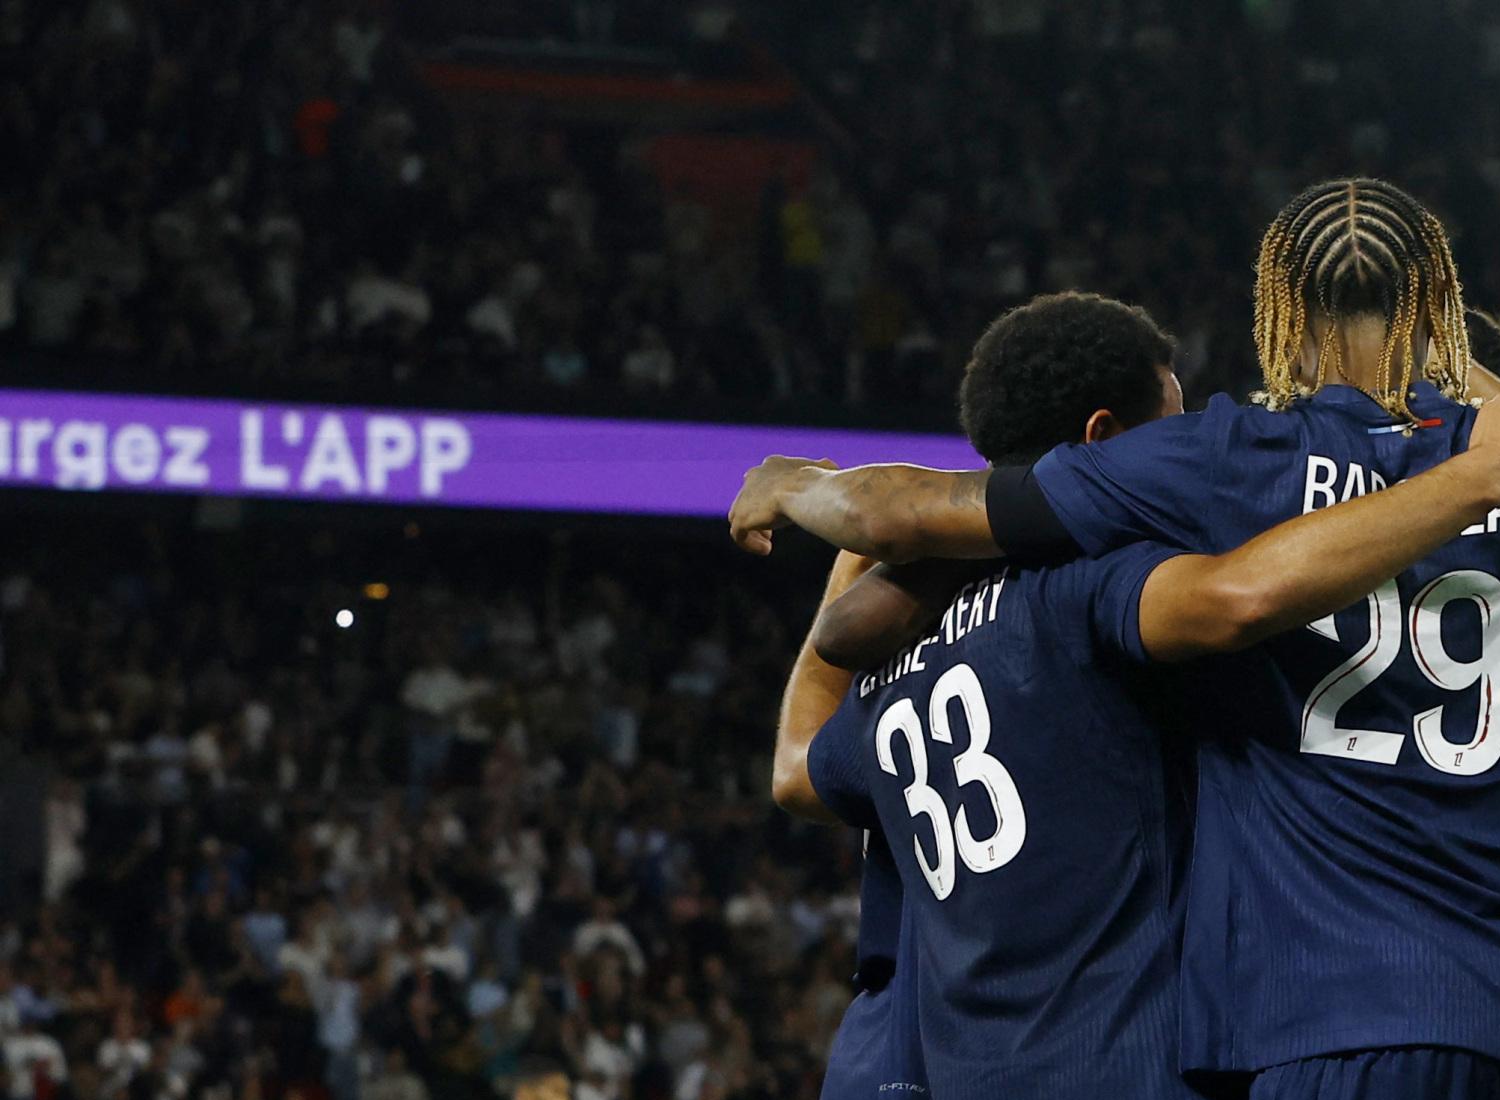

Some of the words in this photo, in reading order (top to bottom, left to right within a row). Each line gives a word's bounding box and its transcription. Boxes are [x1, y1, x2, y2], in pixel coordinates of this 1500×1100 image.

[0, 419, 211, 489] rgez
[240, 409, 472, 496] L'APP
[876, 663, 1026, 900] 33
